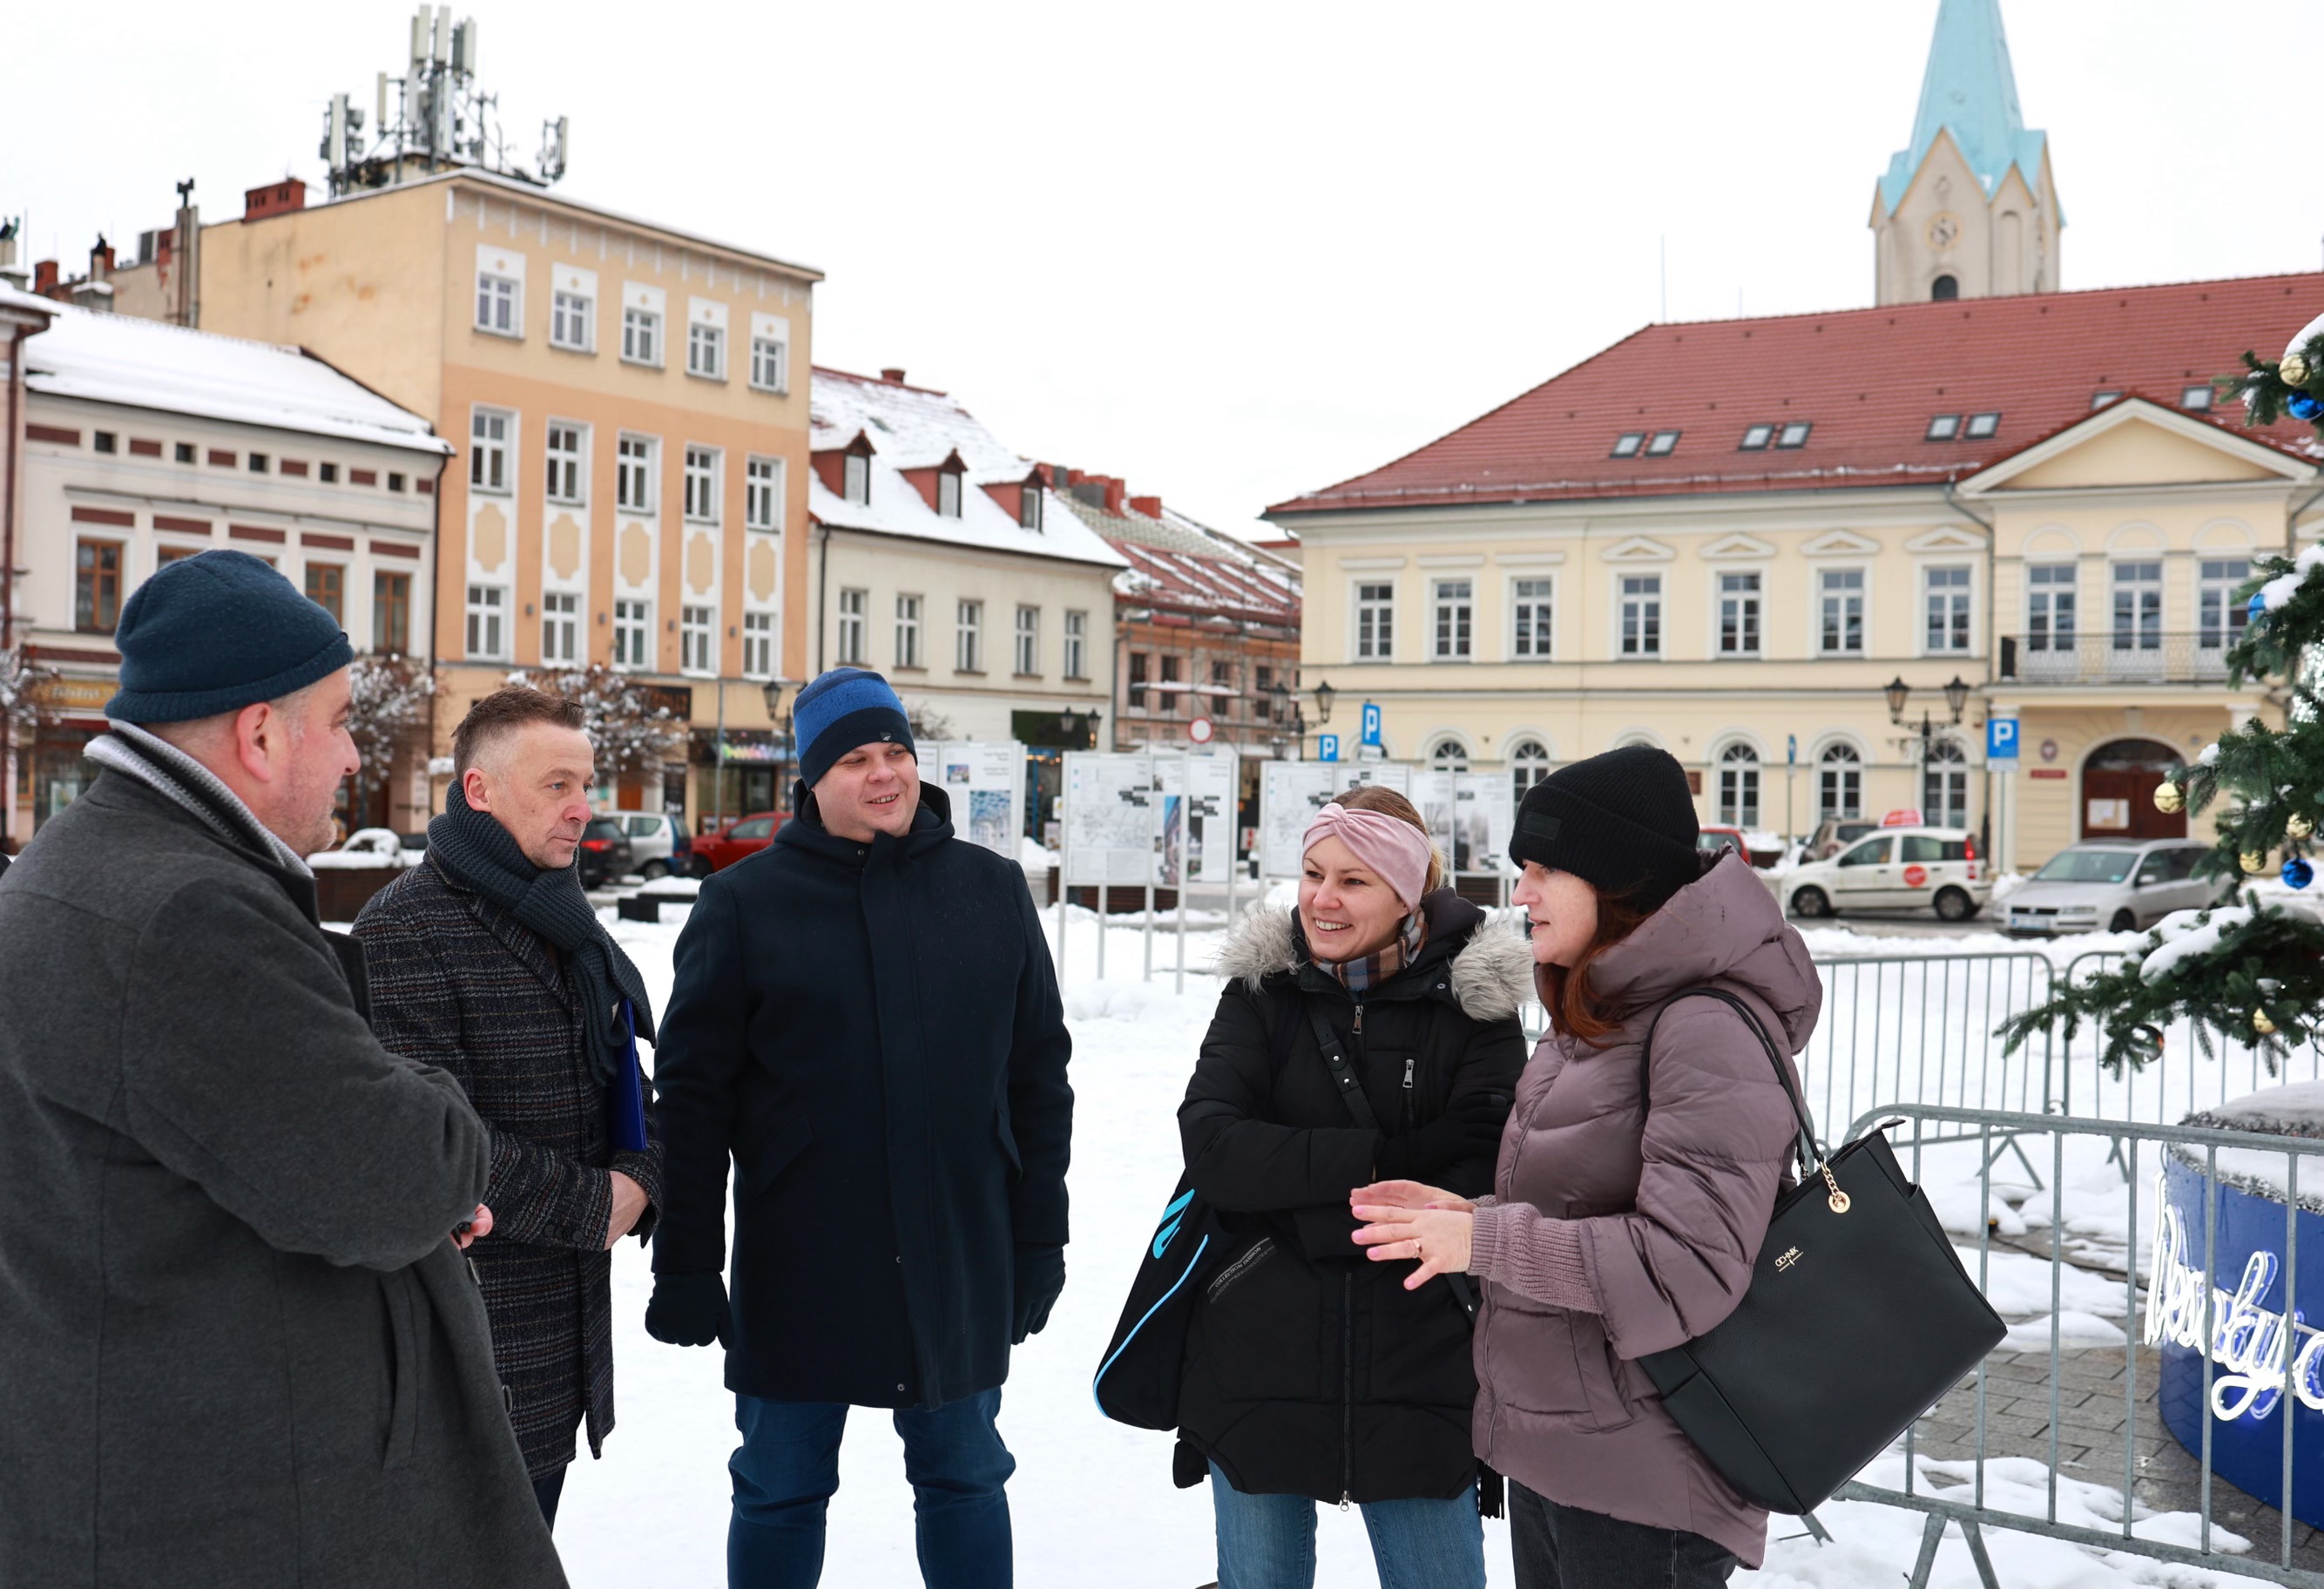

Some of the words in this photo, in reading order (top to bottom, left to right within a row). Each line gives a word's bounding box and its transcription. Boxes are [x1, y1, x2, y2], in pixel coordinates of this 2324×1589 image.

[1365, 708, 1378, 740] P
[1994, 722, 2014, 747] P
[1322, 737, 1336, 760] P
[1215, 1263, 1243, 1287] COLLECTION
[1243, 1247, 1261, 1265] FASHION
[1774, 1245, 1800, 1267] OCHNIK
